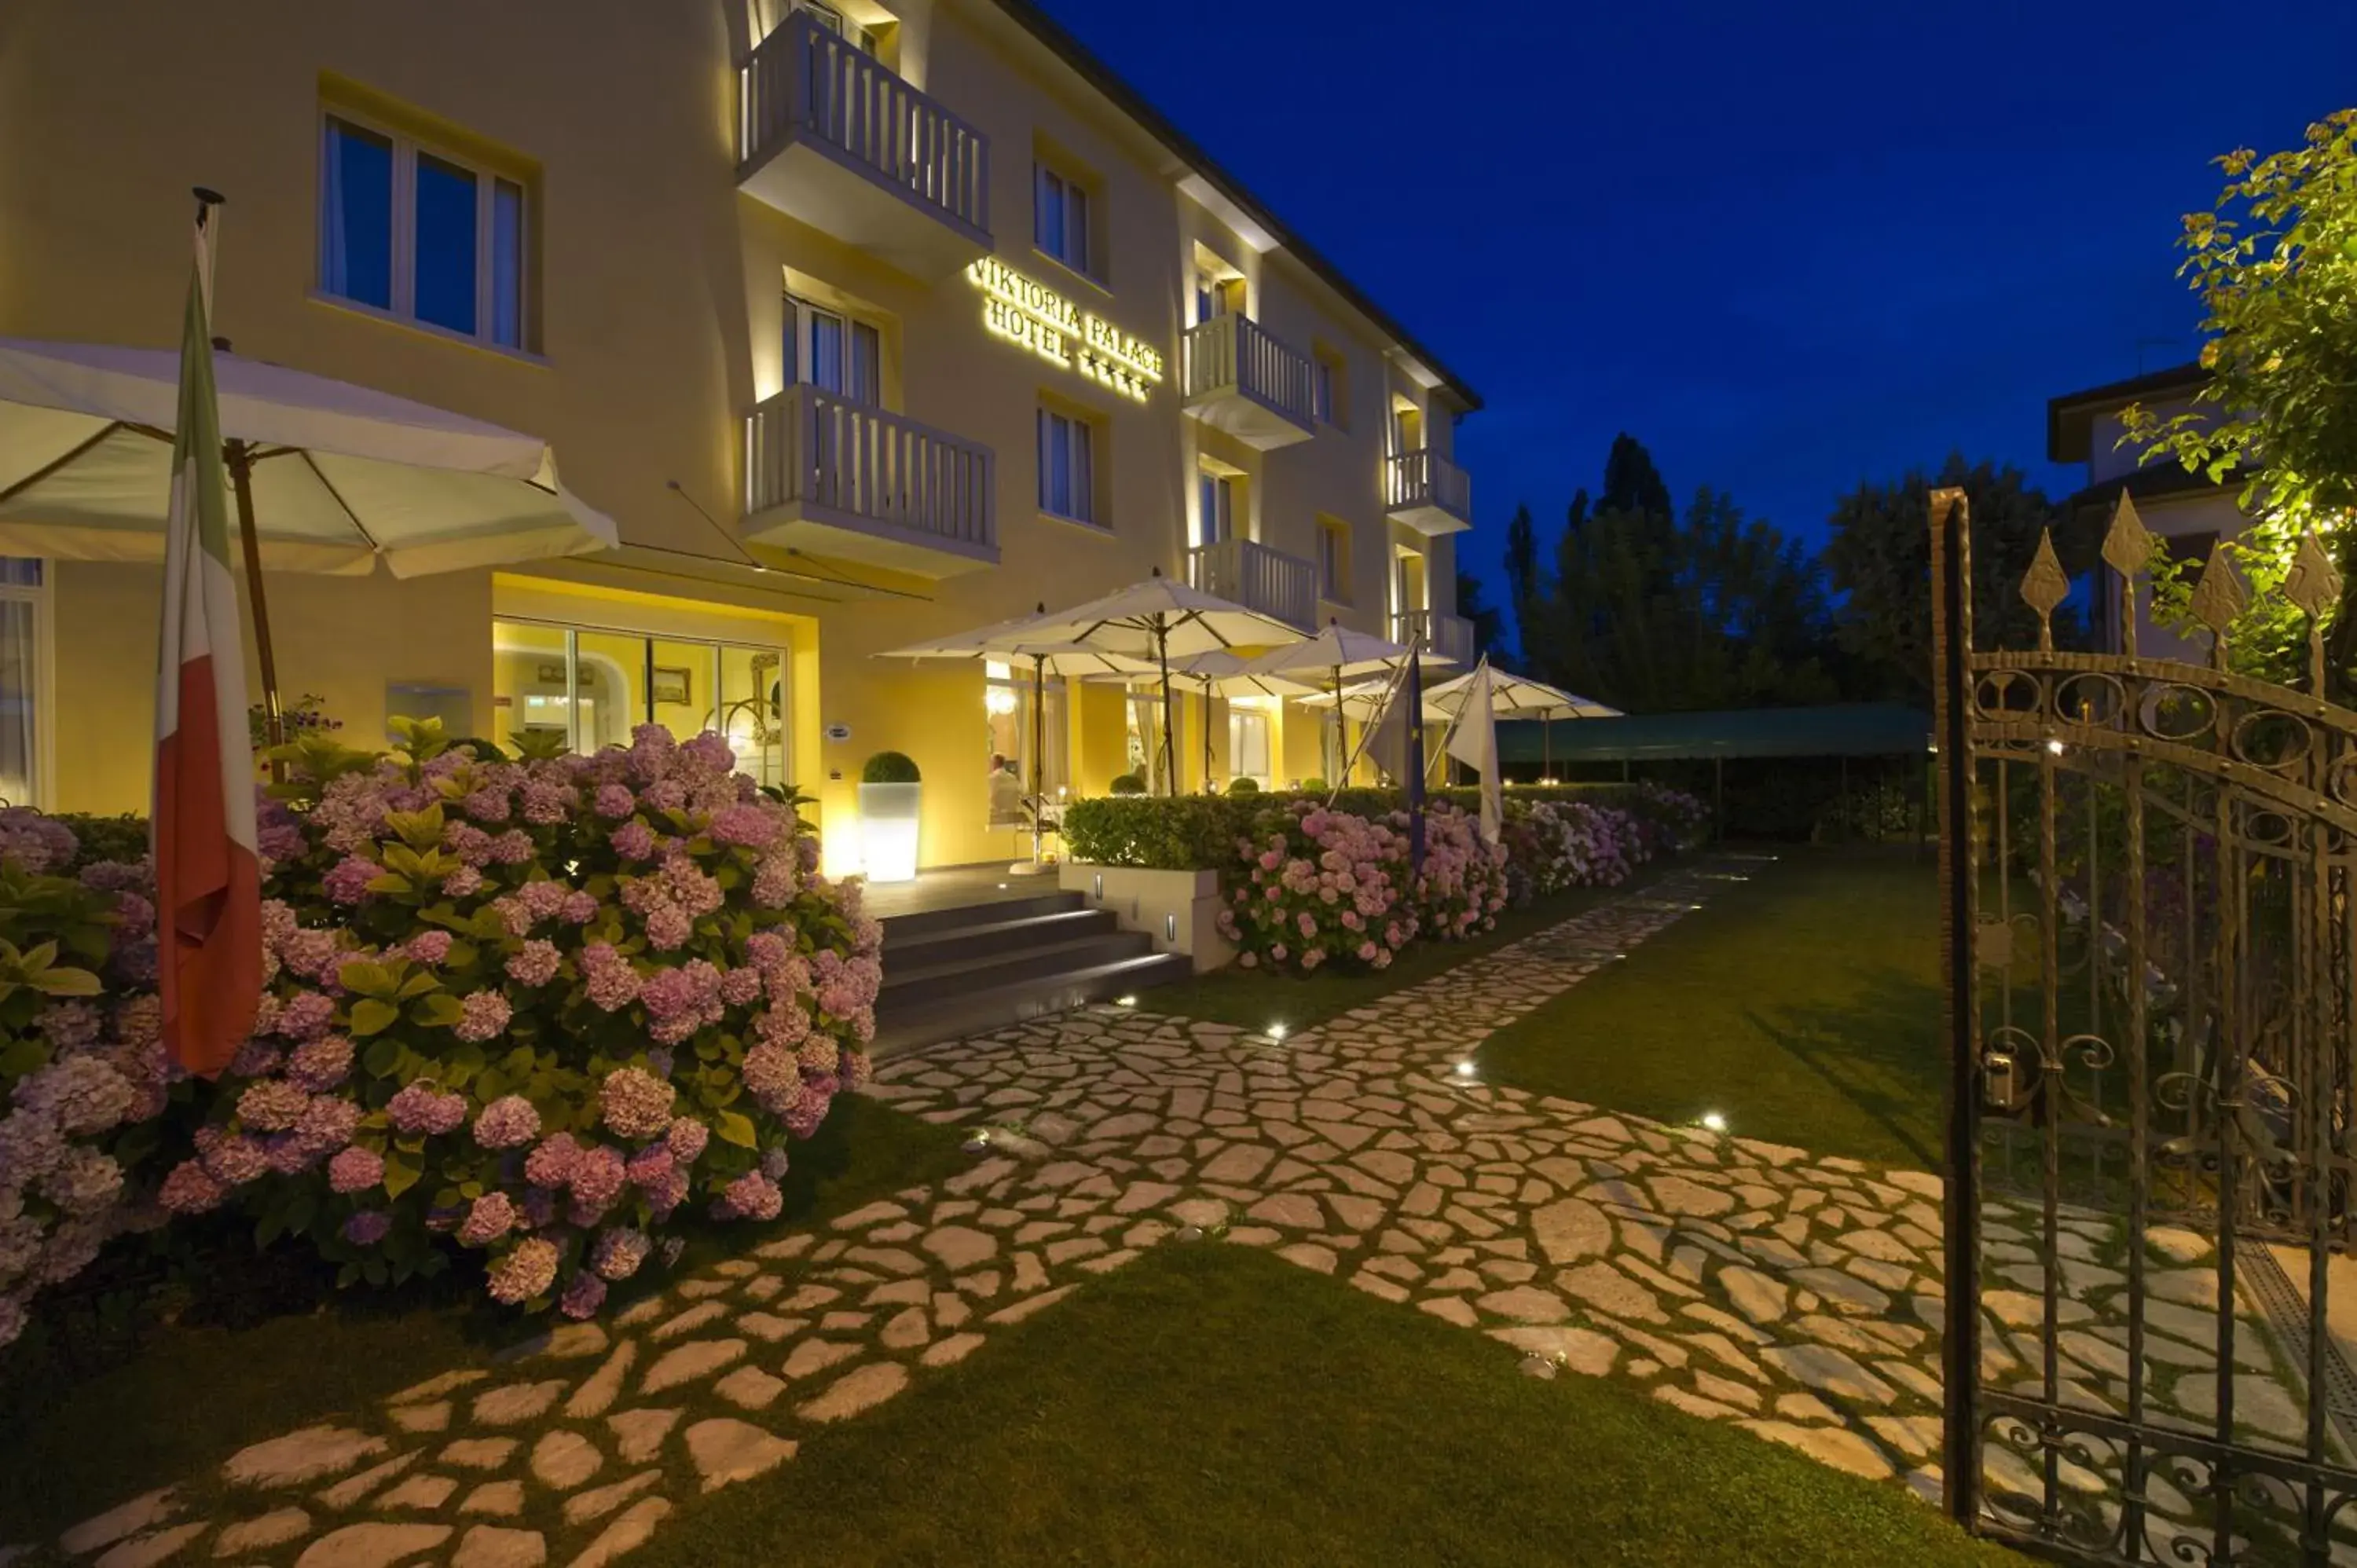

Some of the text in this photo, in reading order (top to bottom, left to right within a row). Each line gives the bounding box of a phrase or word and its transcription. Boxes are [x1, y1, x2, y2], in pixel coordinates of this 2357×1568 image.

[970, 257, 1164, 378] VIKTORIA PALACE
[988, 299, 1072, 364] HOTEL
